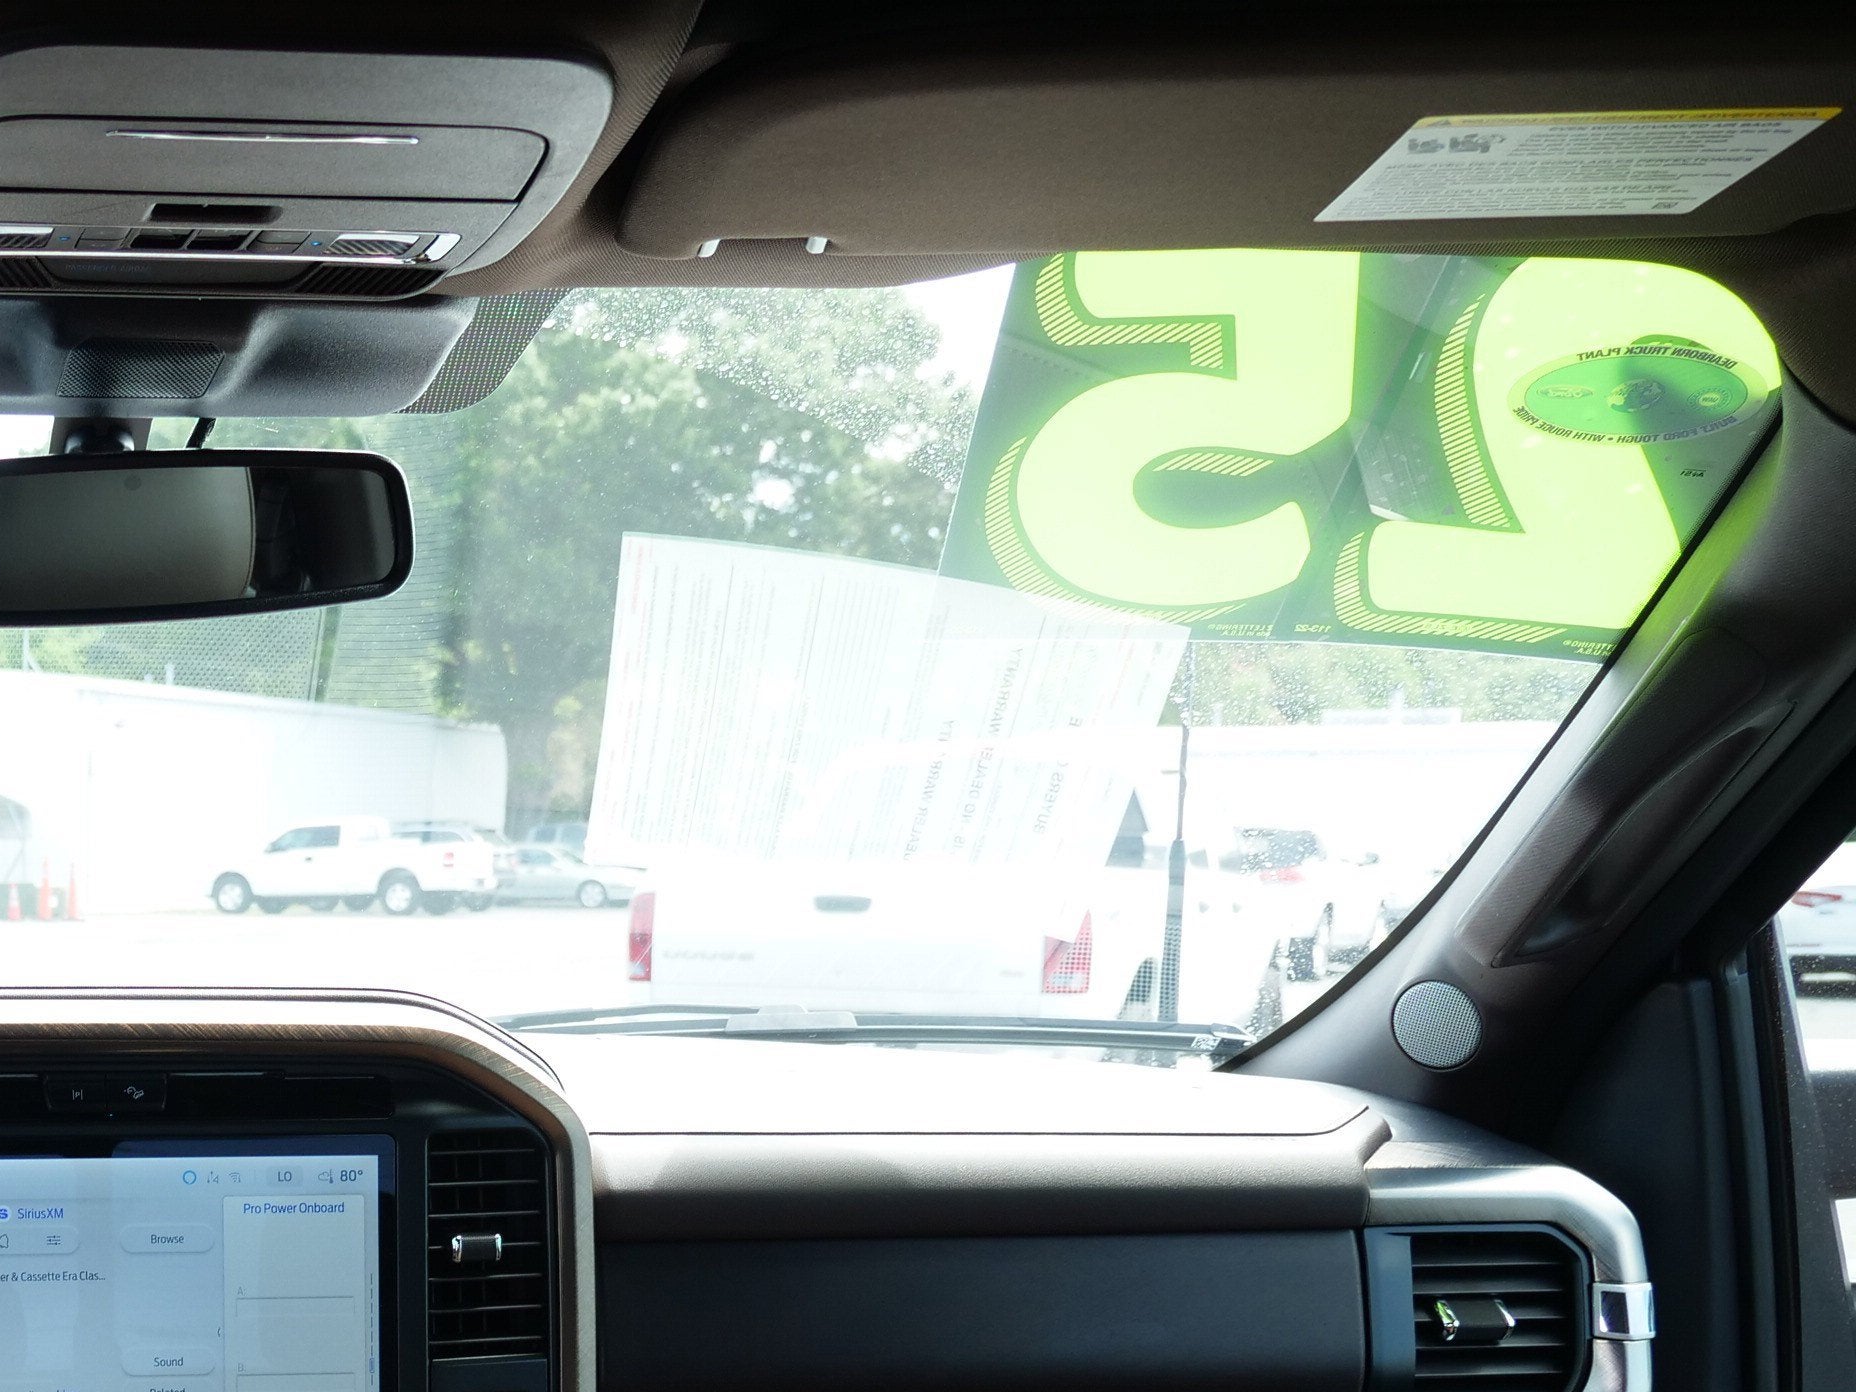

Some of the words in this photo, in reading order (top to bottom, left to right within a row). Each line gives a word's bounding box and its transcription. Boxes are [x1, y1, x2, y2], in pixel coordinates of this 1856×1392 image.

[277, 1171, 293, 1182] LO
[339, 1169, 363, 1182] 80°
[17, 1207, 64, 1220] SiriusXM
[243, 1203, 262, 1215] Pro
[263, 1203, 297, 1214] Power
[299, 1202, 345, 1213] Onboard
[150, 1233, 185, 1244] Browse
[10, 1272, 19, 1282] &
[20, 1271, 61, 1282] Cassette
[62, 1271, 78, 1281] Era
[153, 1357, 184, 1368] Sound
